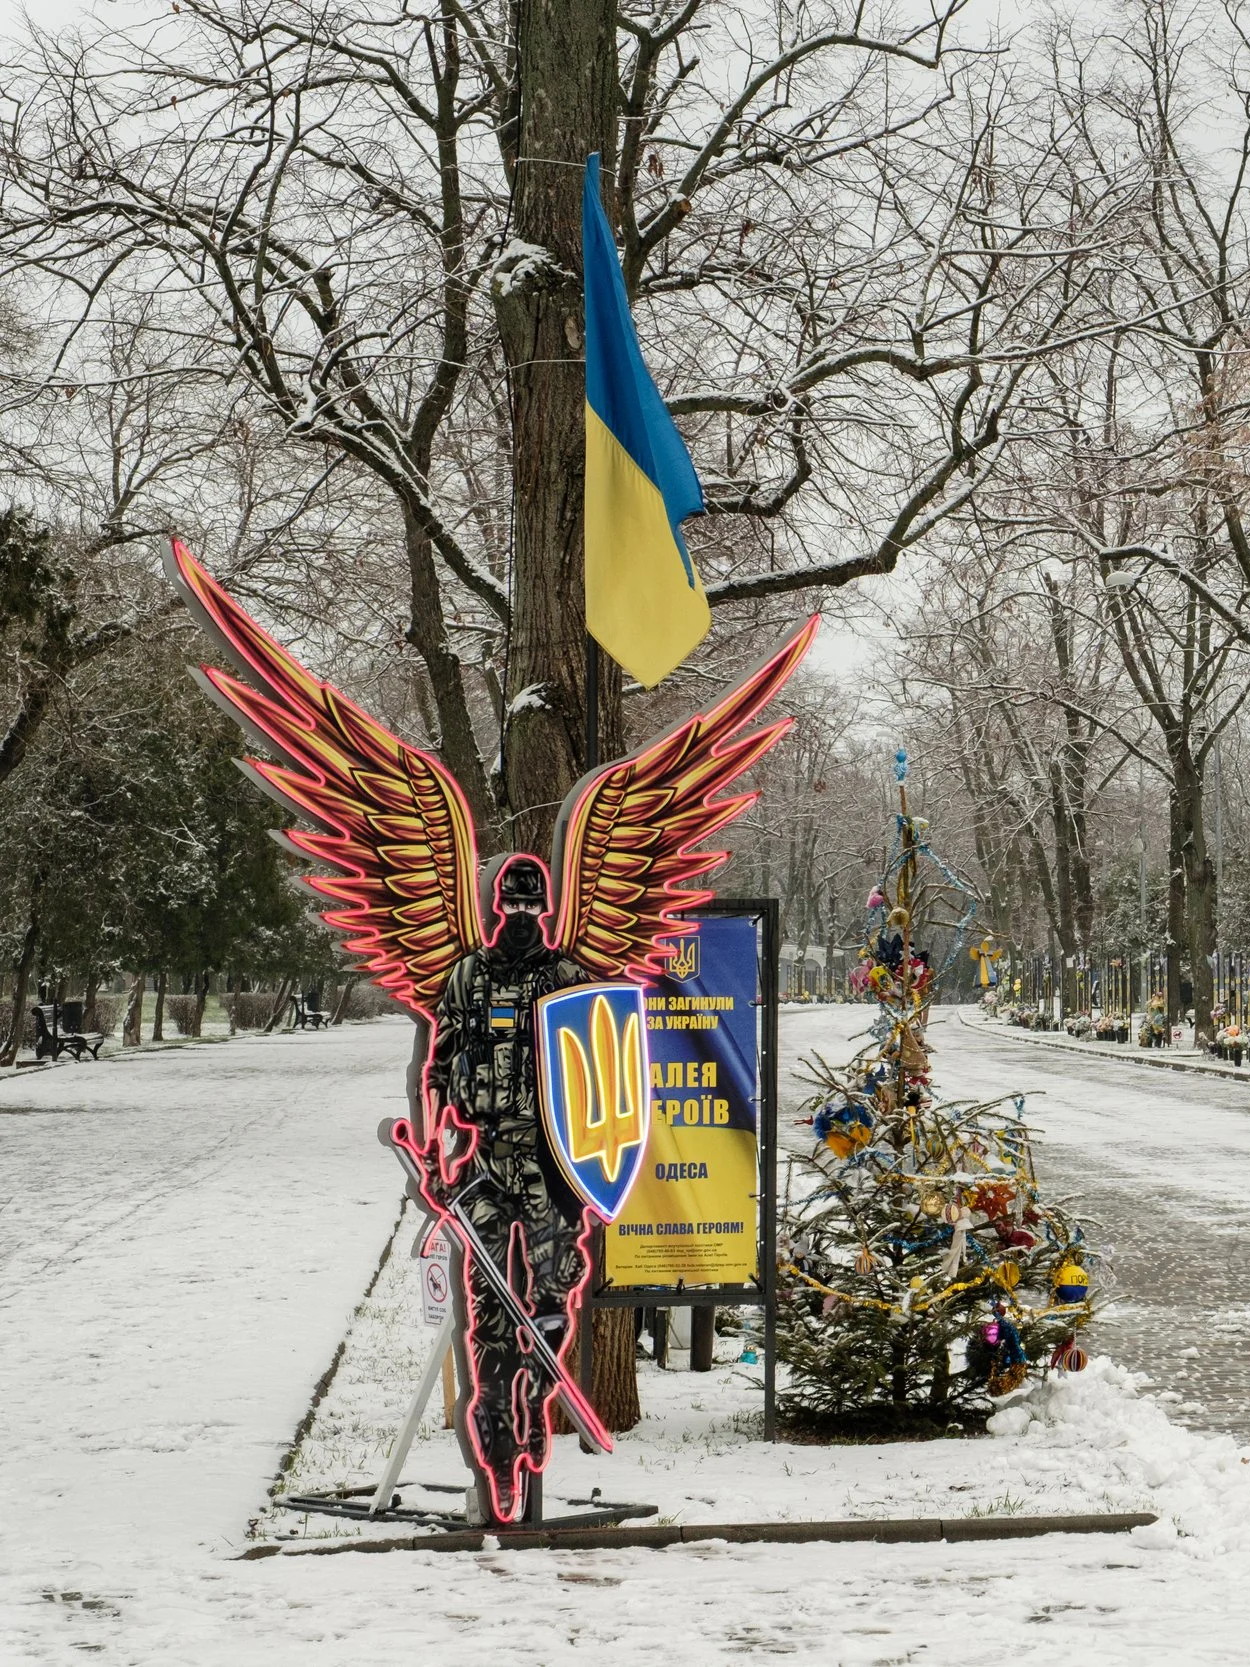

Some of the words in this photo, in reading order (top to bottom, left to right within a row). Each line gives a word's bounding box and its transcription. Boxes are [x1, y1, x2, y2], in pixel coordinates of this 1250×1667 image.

[668, 996, 734, 1011] ЗАГИНУЛИ
[646, 1015, 664, 1030] ЗА
[666, 1014, 719, 1030] УКРАЇНУ
[649, 1062, 717, 1088] АЛЕЯ
[650, 1094, 730, 1126] ЕРОЇВ
[655, 1162, 709, 1182] ОДЕСА
[618, 1223, 654, 1236] ВІЧНА
[656, 1222, 694, 1236] СЛАВА
[696, 1221, 744, 1235] ГЕРОЯМ!
